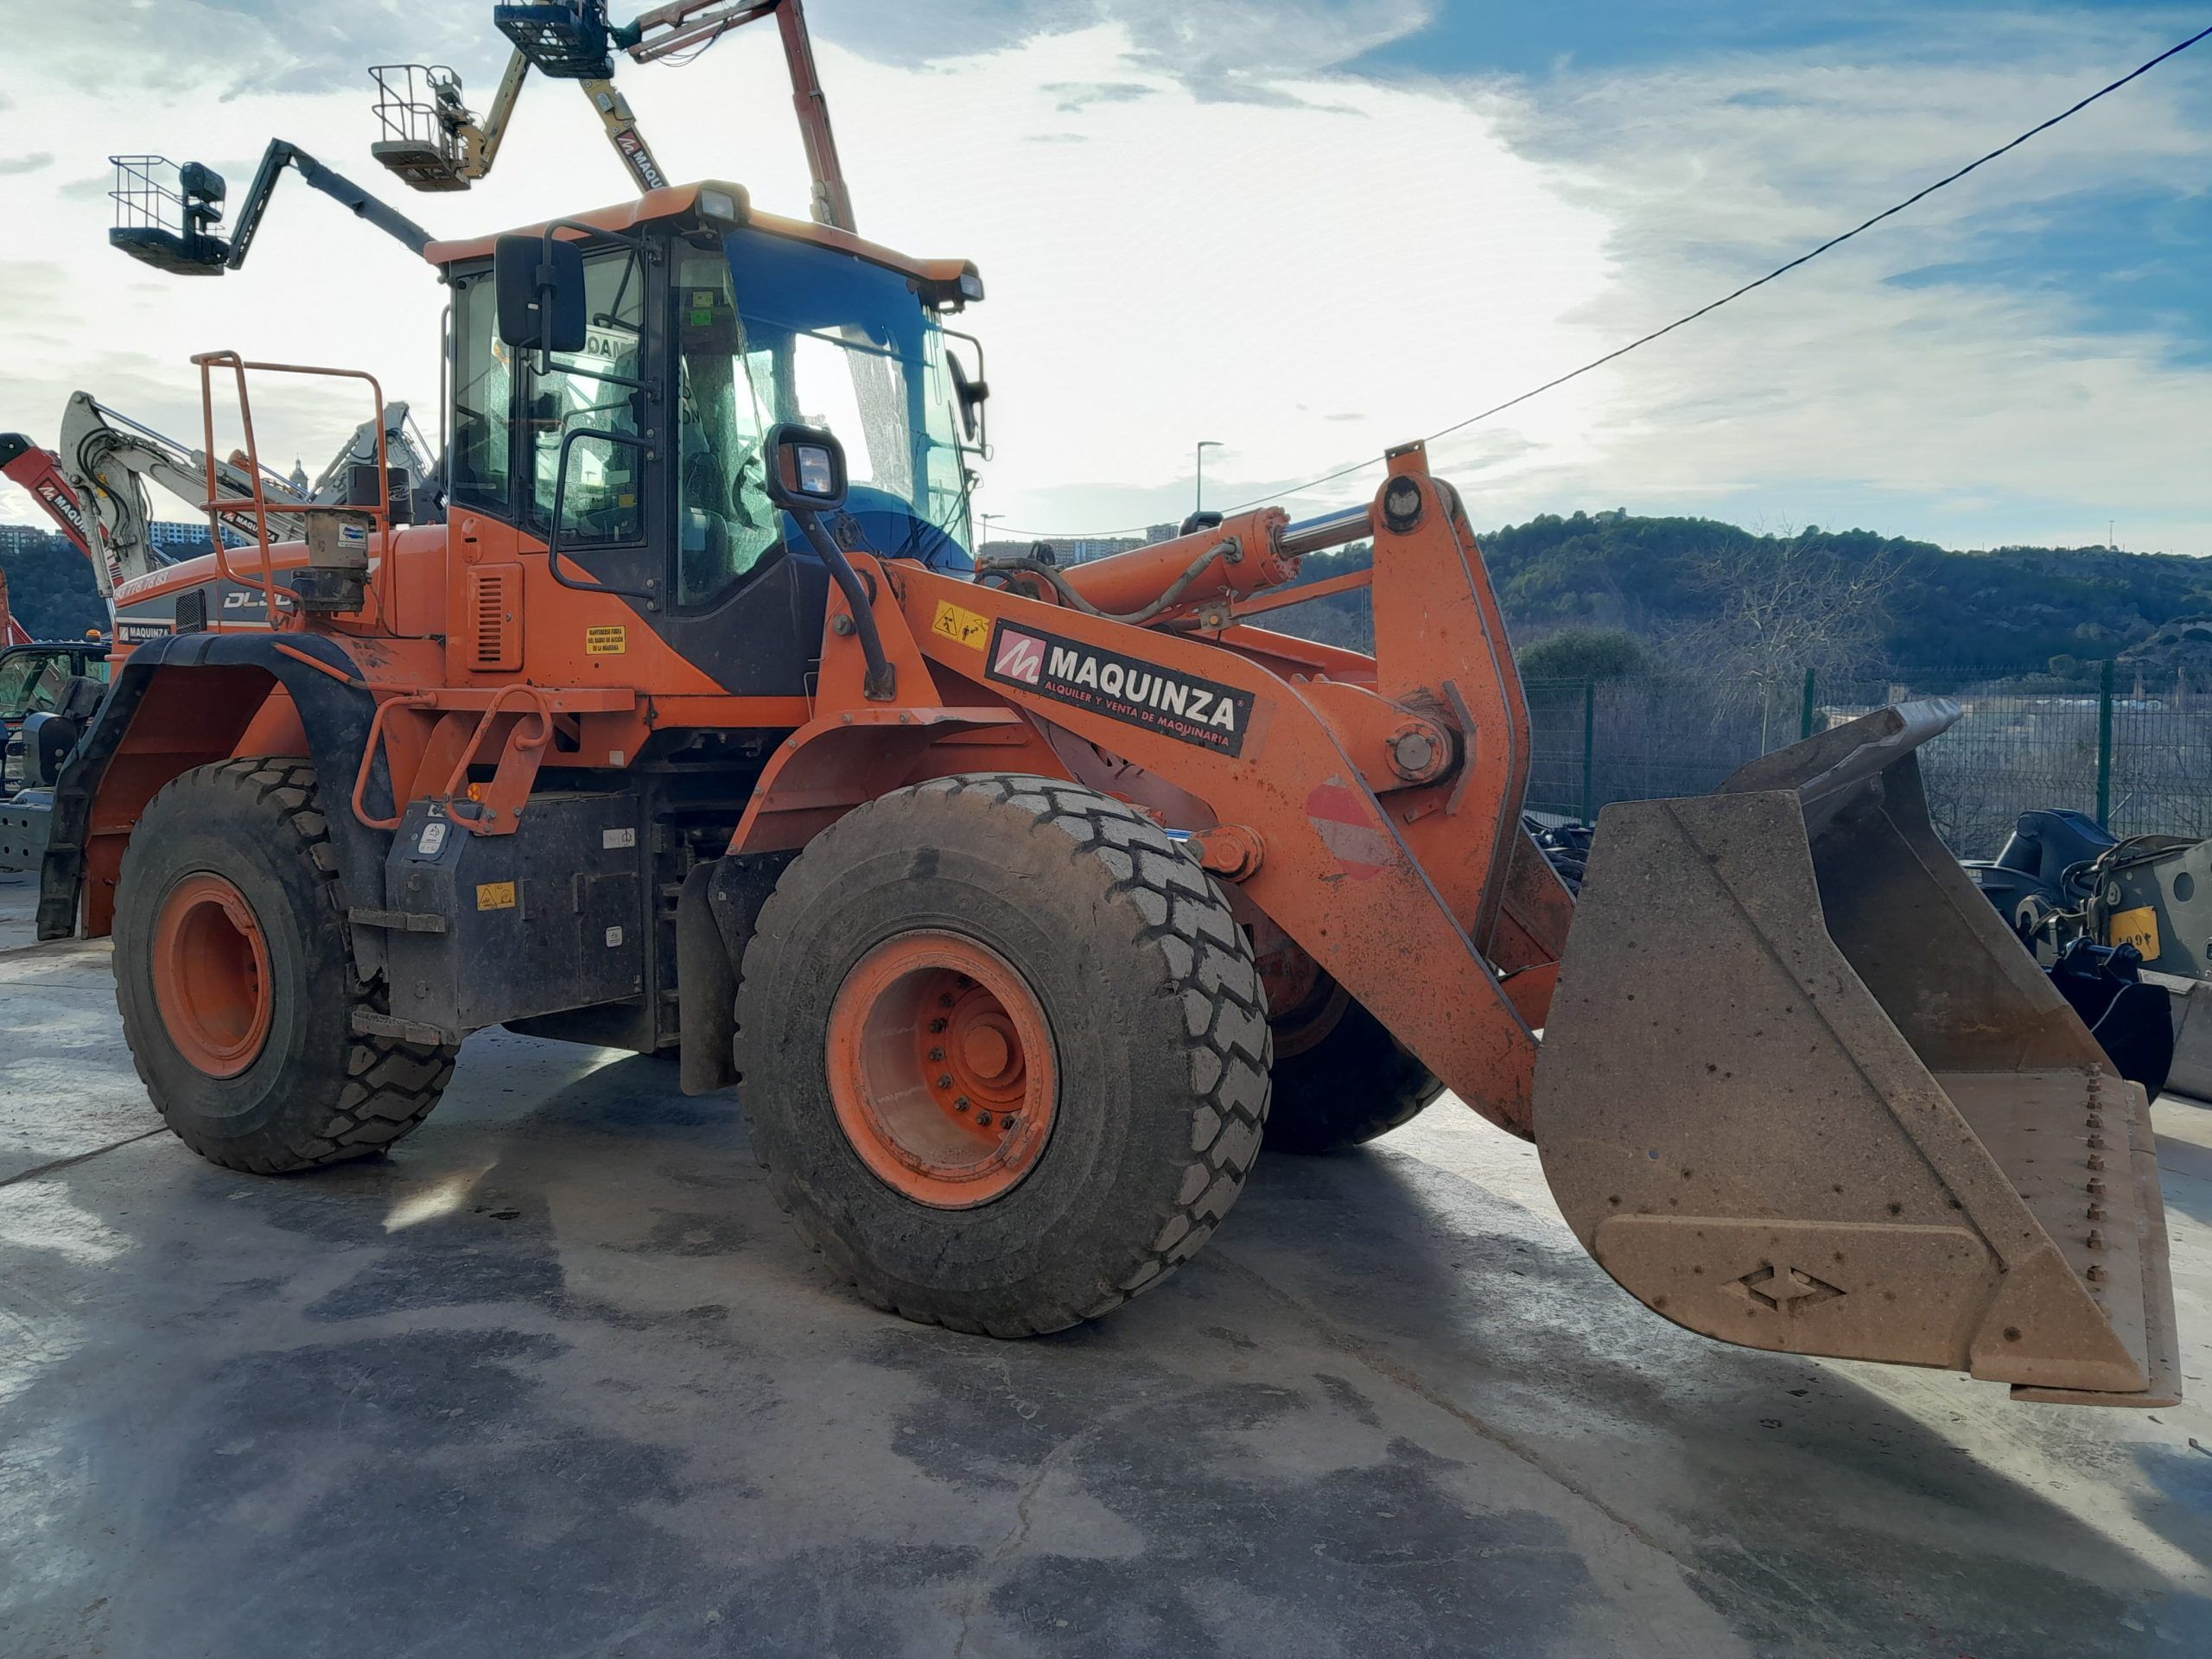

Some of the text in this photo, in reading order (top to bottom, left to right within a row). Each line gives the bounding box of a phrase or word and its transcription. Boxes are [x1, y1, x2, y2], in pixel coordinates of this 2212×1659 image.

[130, 627, 169, 638] MAQUINZA
[1045, 681, 1230, 747] ALQUILER Y VENTA DE MAQUINARIA
[1048, 646, 1235, 731] MAQUINZA
